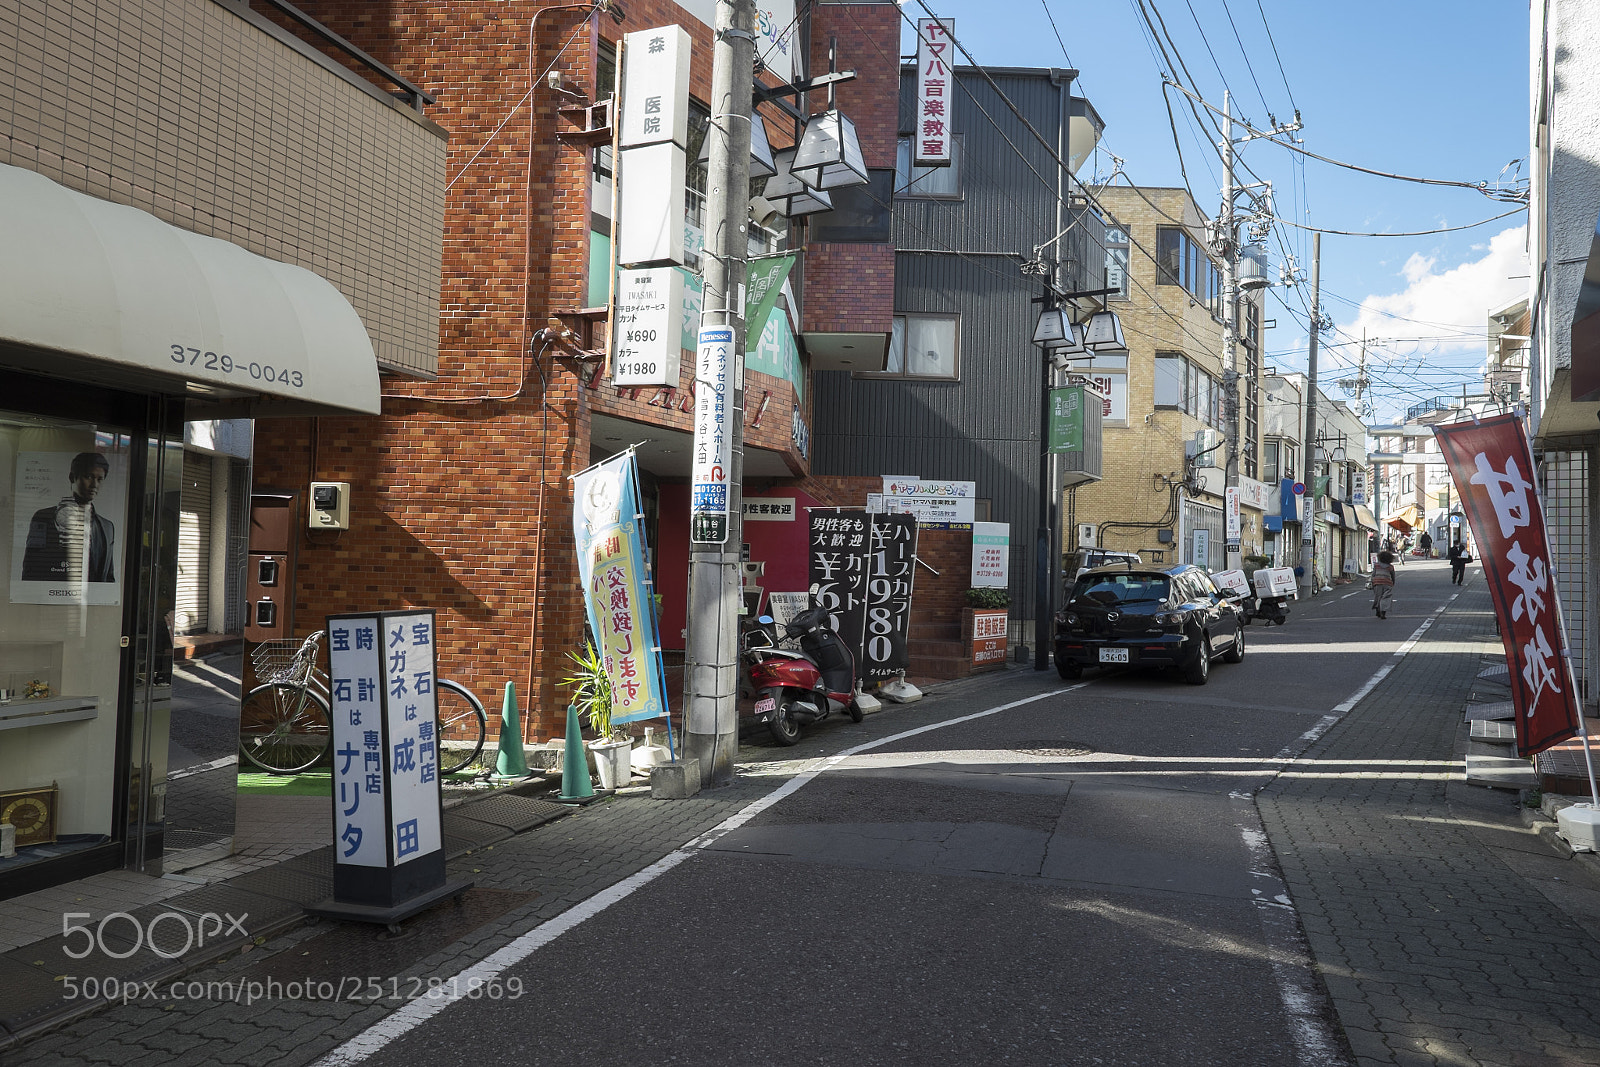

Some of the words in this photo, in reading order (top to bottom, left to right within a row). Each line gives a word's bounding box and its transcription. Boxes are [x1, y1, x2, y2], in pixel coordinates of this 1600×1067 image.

[648, 36, 665, 54] 森
[922, 23, 947, 156] ヤマハ音楽教室
[643, 95, 662, 135] 医院
[628, 290, 657, 301] IWASAKI
[635, 277, 652, 285] 美容室
[618, 303, 666, 313] 平日タイムサービス
[618, 314, 638, 324] カット
[626, 329, 657, 343] ¥690
[700, 332, 729, 342] Benesse
[170, 343, 305, 388] 3729-0043
[618, 348, 640, 358] カラー
[618, 362, 657, 376] ¥1980
[811, 518, 864, 532] 男性客も
[811, 533, 864, 547] 大歓迎
[844, 553, 862, 611] カット
[867, 523, 893, 662] ¥1980
[332, 628, 352, 702] 宝石
[355, 627, 376, 702] 時計
[389, 625, 408, 700] メガネ
[411, 622, 432, 696] 宝石
[349, 709, 362, 726] は
[404, 704, 417, 721] は
[363, 730, 382, 795] 専門店
[418, 720, 435, 784] 専門店
[337, 742, 363, 858] ナリタ
[392, 737, 419, 859] 成田
